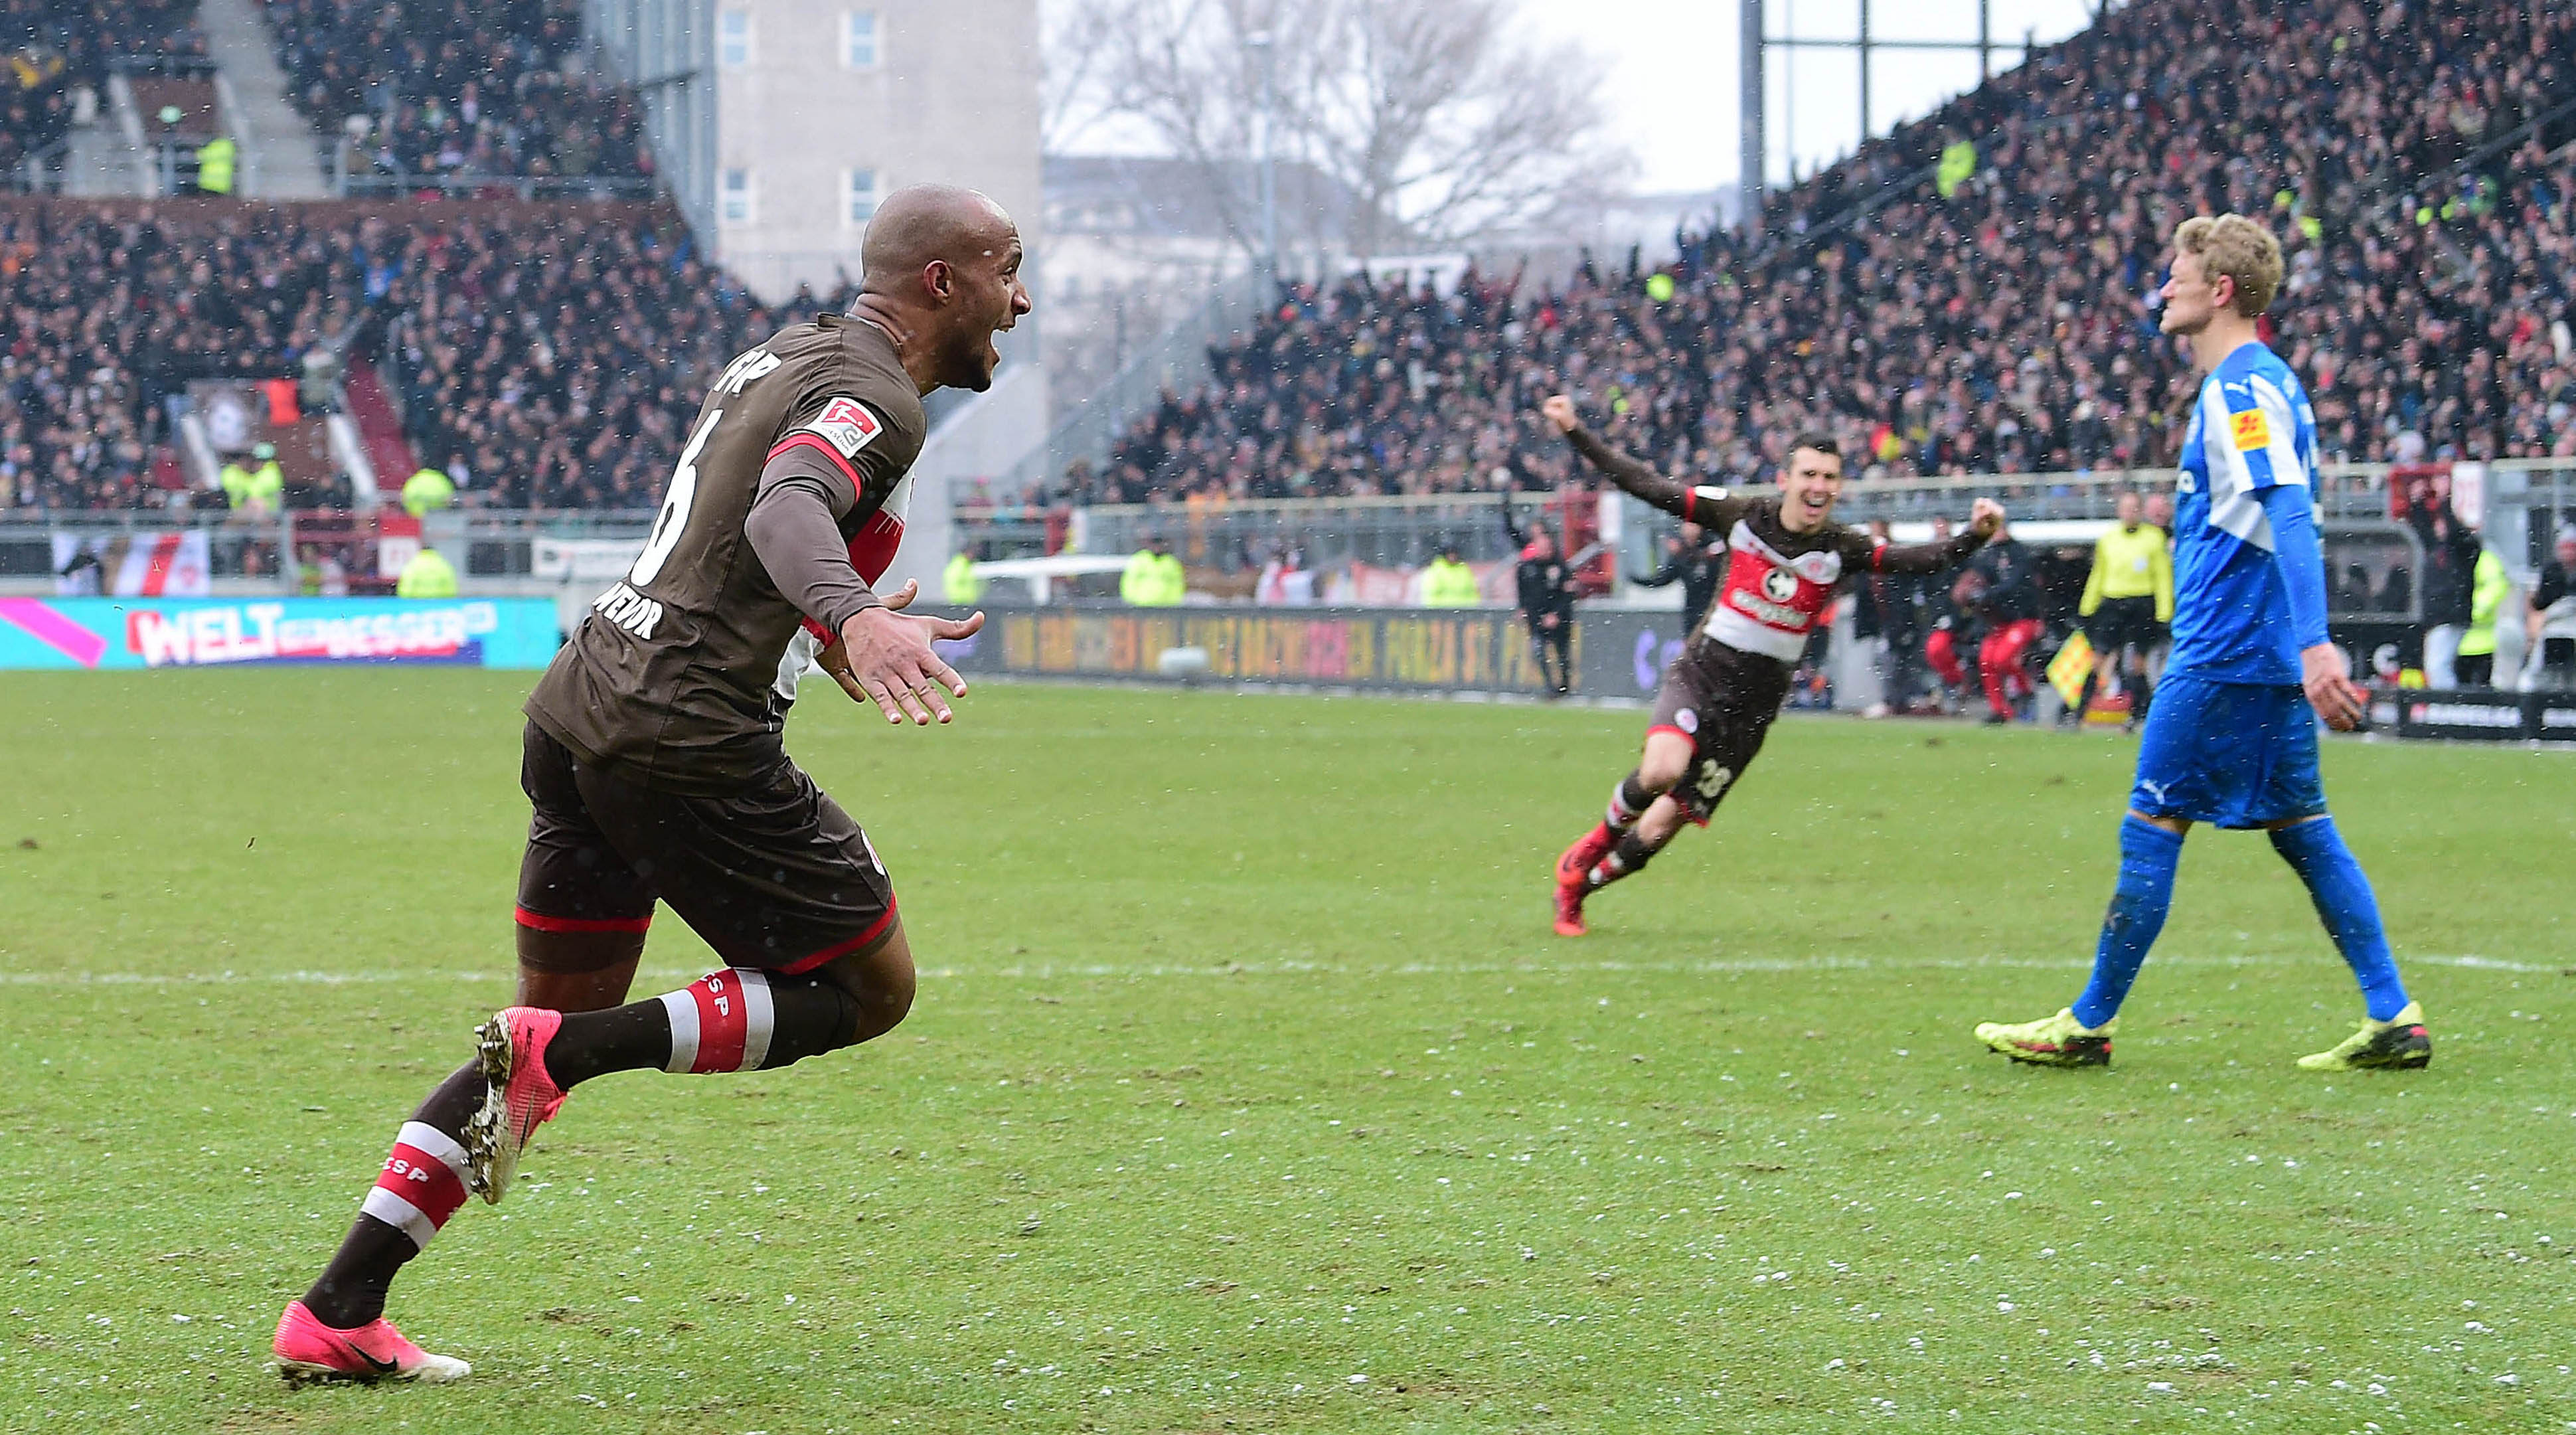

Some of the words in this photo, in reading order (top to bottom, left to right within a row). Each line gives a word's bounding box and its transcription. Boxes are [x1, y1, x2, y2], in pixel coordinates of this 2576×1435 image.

[629, 408, 724, 587] 6
[137, 604, 284, 667] WELT
[592, 581, 663, 640] VEVOR
